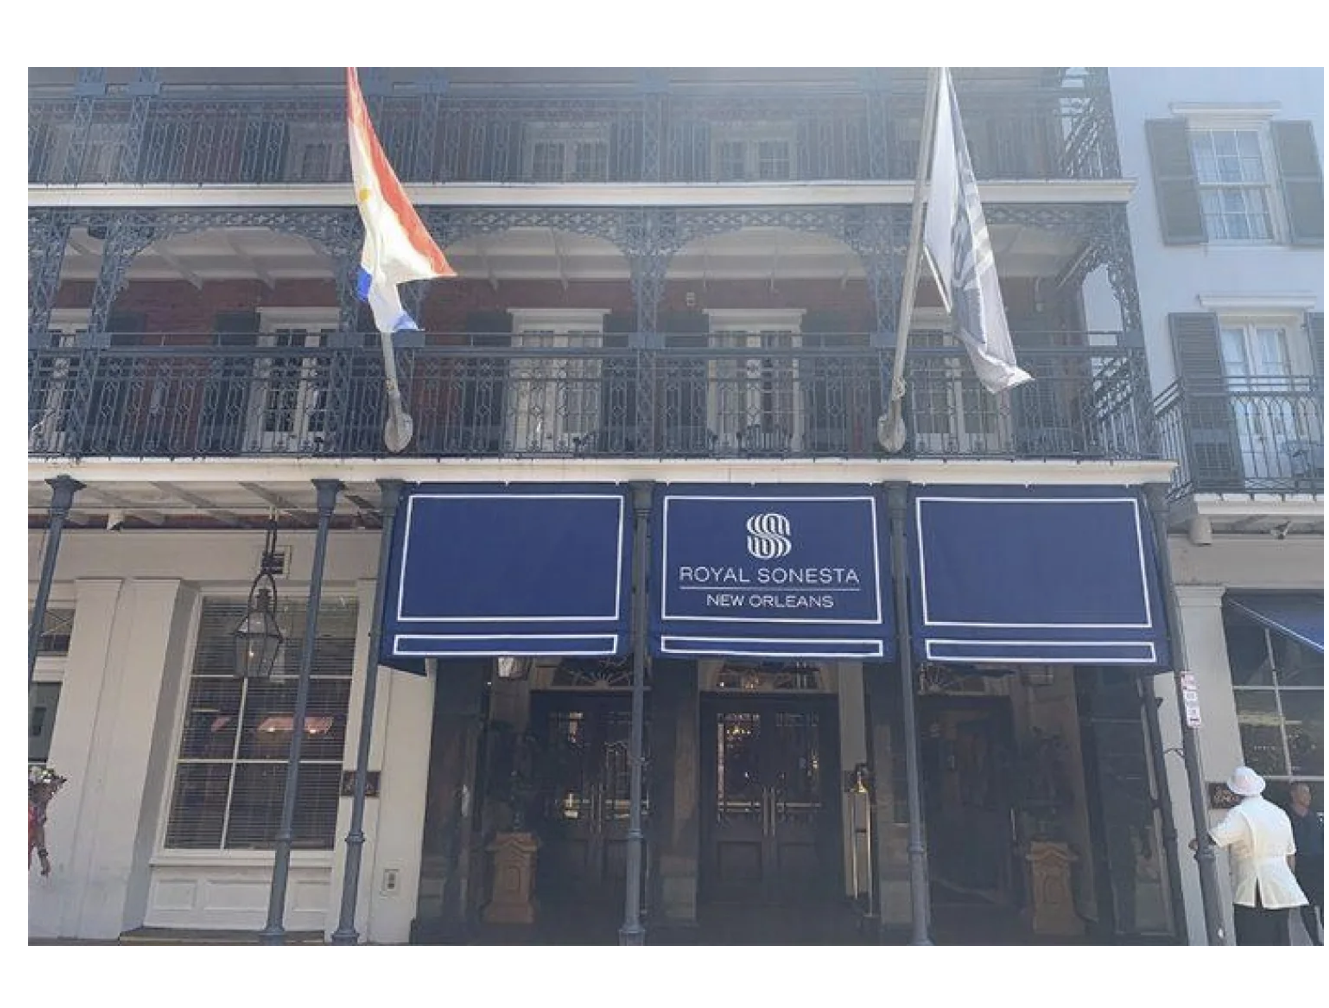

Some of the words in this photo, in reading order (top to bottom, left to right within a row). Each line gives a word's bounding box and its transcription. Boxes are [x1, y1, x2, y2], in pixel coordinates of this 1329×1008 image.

[679, 566, 751, 583] ROYAL
[757, 567, 860, 584] SONESTA
[706, 594, 745, 607] NEW
[748, 594, 835, 608] ORLEANS
